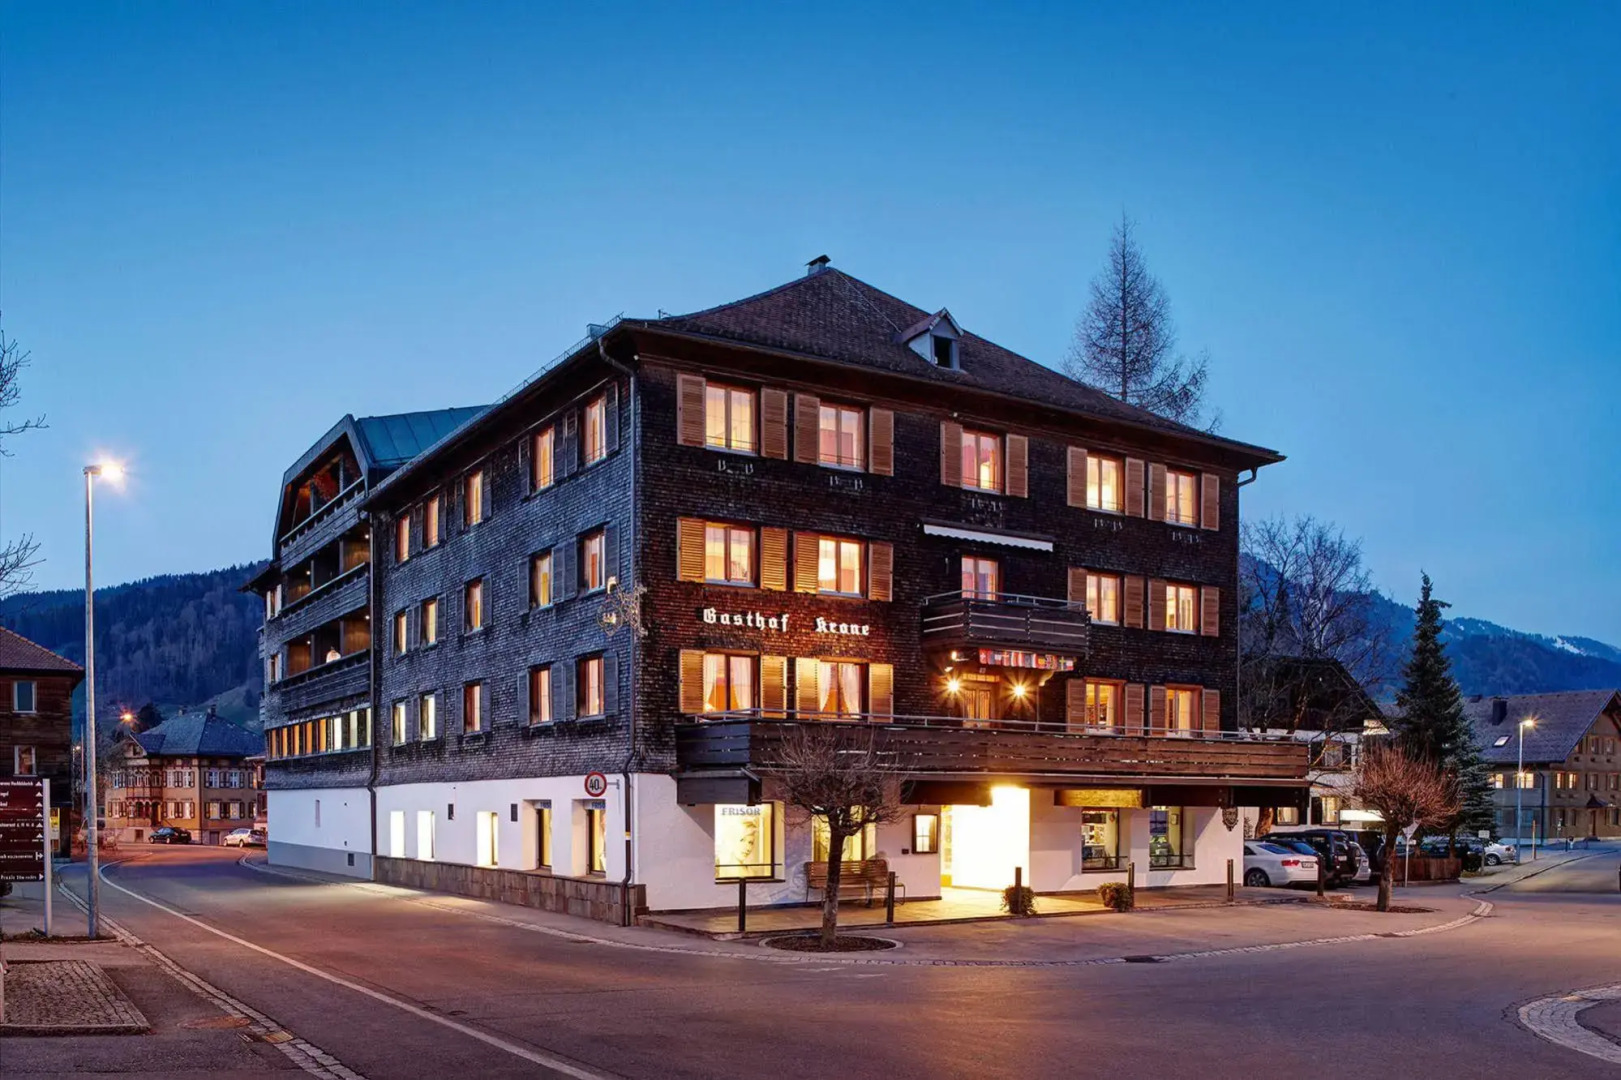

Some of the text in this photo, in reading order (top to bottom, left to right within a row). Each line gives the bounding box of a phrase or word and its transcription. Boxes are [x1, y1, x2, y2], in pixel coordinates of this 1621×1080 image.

[702, 607, 871, 636] Gasthof Krone
[589, 778, 600, 791] 40
